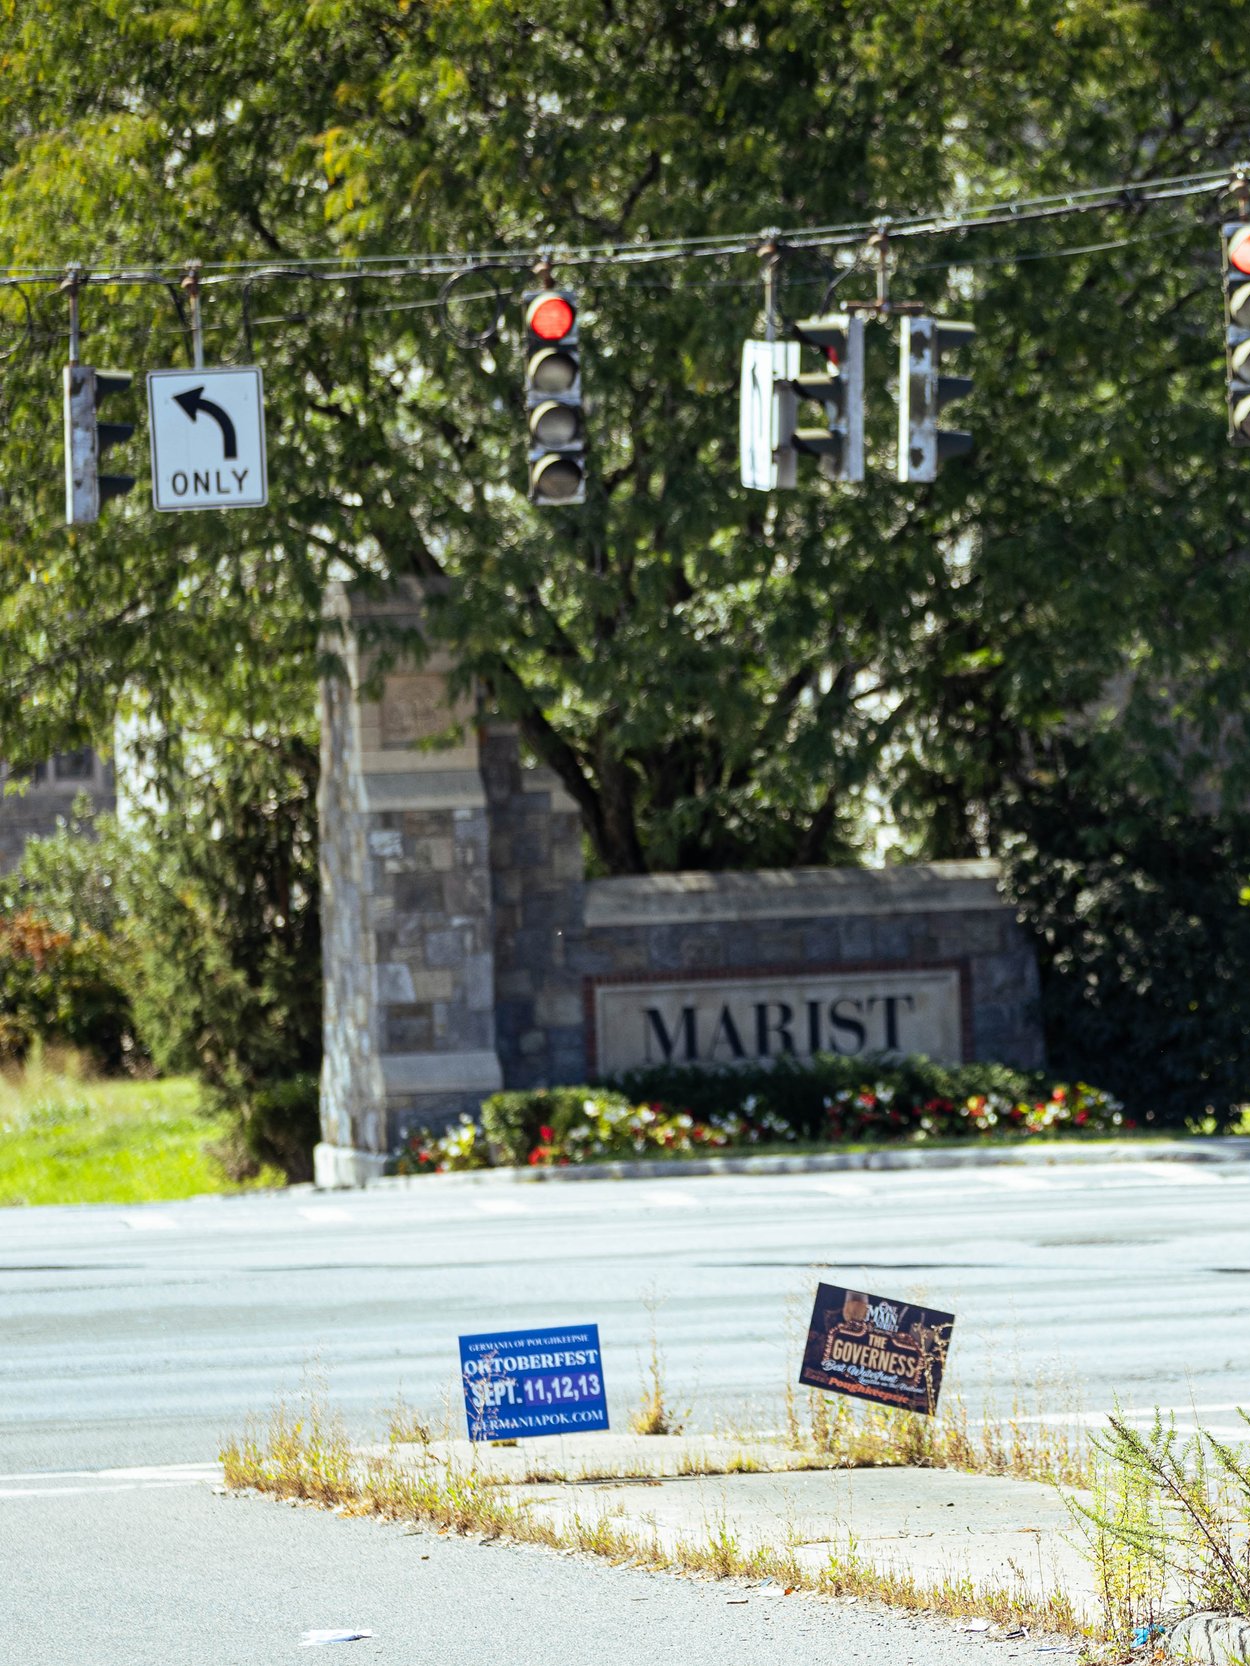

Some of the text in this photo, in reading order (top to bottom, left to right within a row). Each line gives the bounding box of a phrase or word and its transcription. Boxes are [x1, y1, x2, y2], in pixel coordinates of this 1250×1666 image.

[171, 468, 249, 496] ONLY
[643, 994, 915, 1064] MARIST
[468, 1334, 590, 1353] GERMANIA OF POUGHKEEPSIE
[868, 1334, 888, 1350] THE
[464, 1349, 599, 1375] OKTOBERFEST
[832, 1339, 917, 1378] GOVERNESS
[471, 1373, 600, 1408] SEPT. 11,12,13
